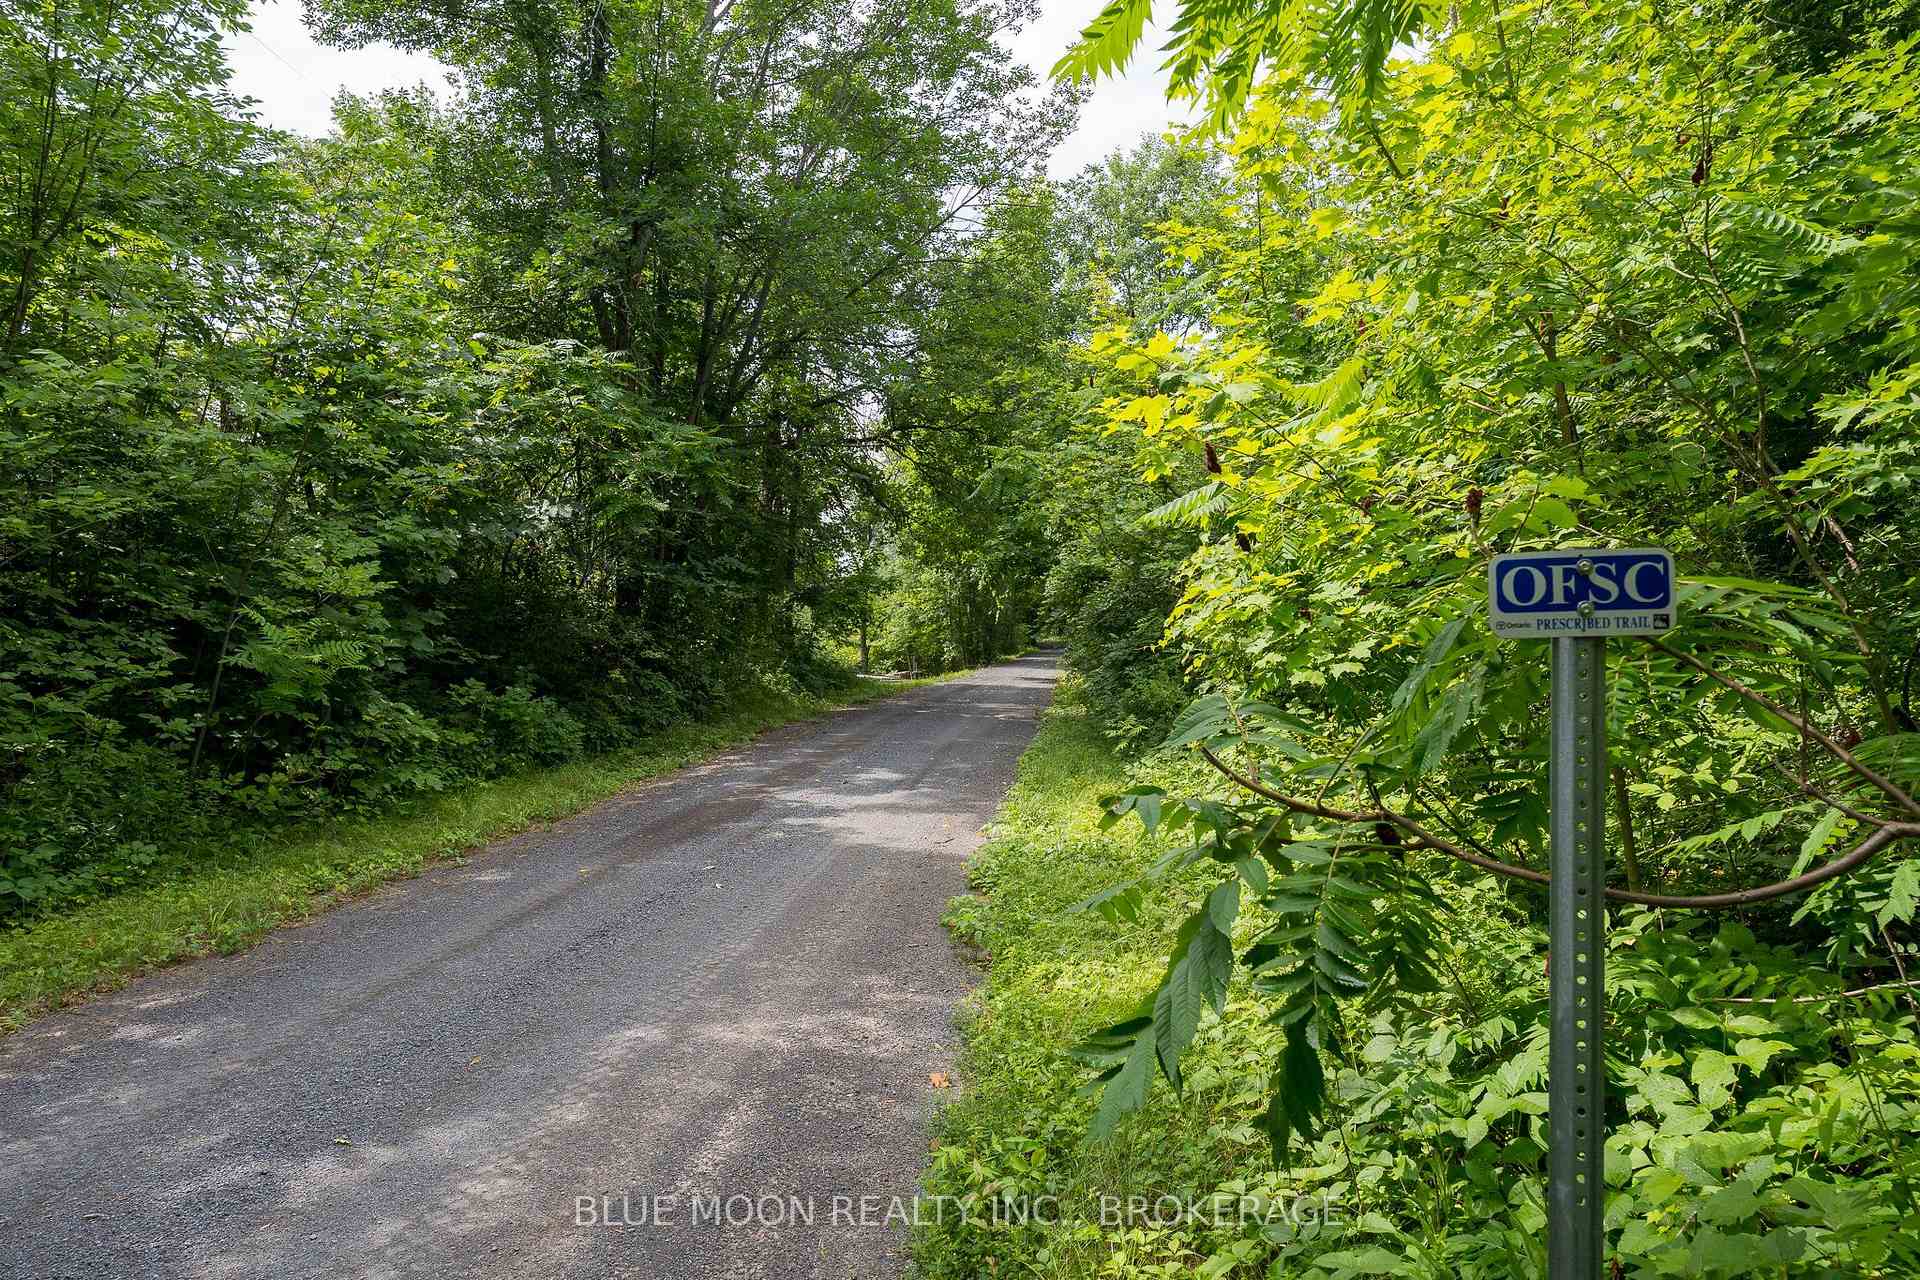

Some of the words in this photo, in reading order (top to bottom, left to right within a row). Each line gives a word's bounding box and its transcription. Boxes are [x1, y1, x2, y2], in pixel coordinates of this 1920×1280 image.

[1502, 562, 1664, 606] OFSC
[1536, 615, 1610, 631] PRESCRIBED
[1614, 615, 1650, 629] TRAIL
